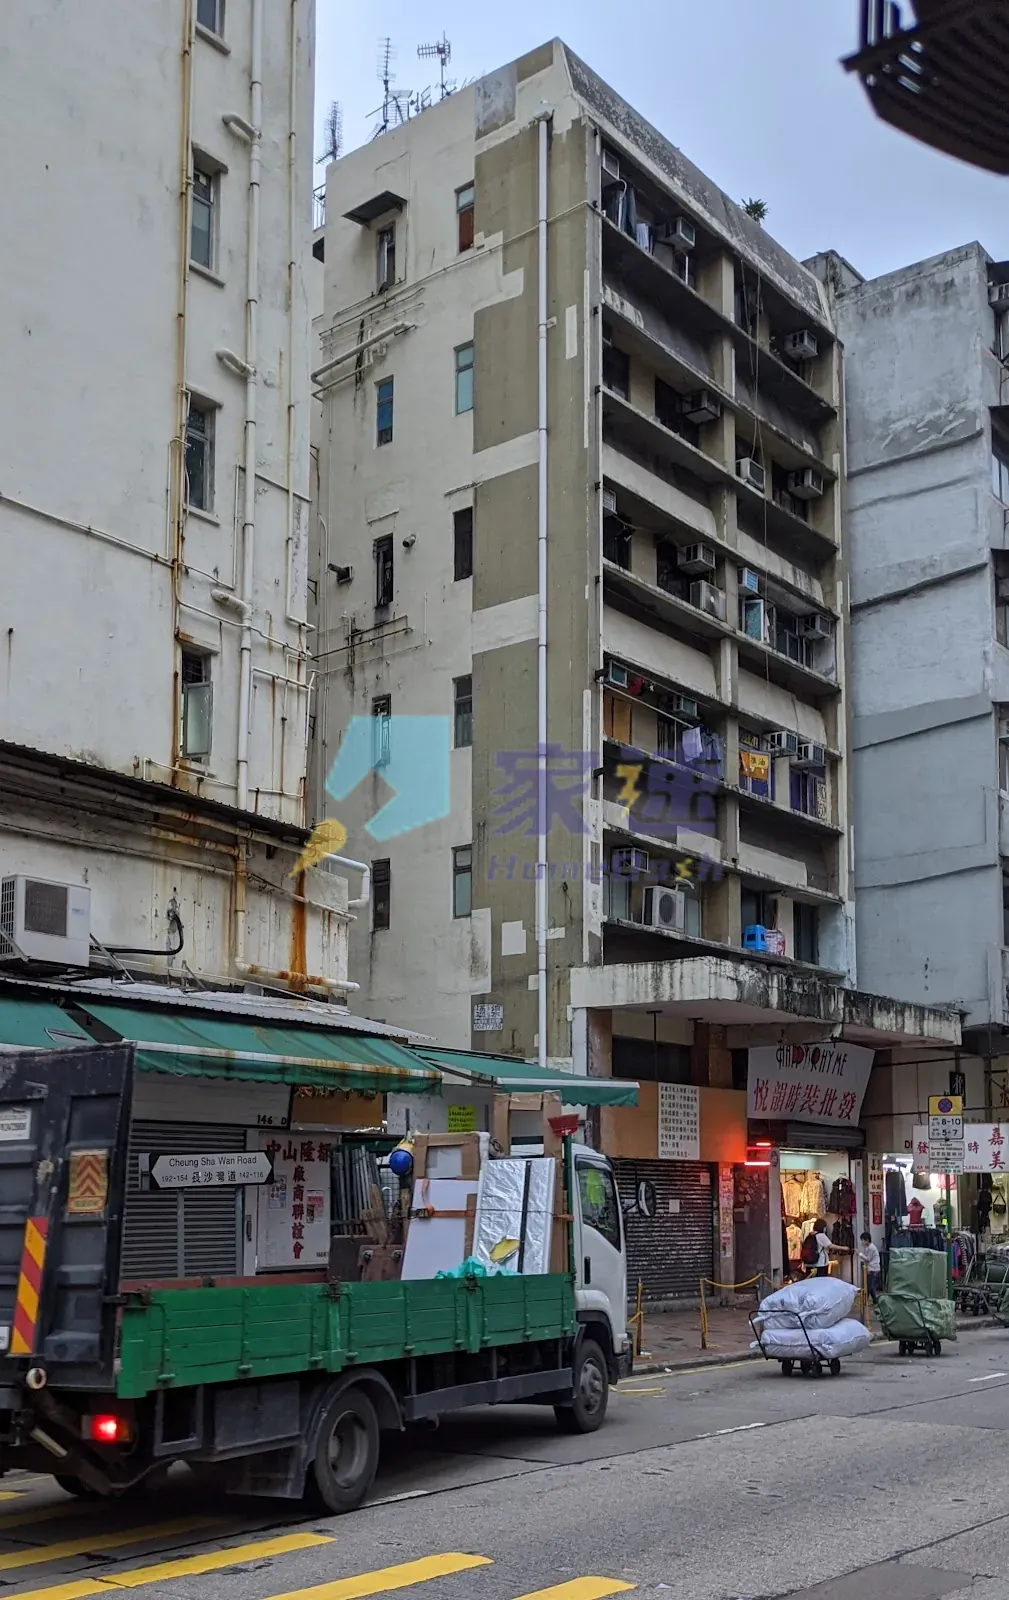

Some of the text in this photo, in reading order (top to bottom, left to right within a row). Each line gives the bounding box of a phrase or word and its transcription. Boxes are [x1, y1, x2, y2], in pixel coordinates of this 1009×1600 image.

[811, 1047, 848, 1076] RHYME
[257, 1114, 273, 1125] 146
[941, 1118, 961, 1126] 8-10
[942, 1129, 958, 1137] 5-7
[967, 1141, 980, 1154] 時
[988, 1127, 1006, 1170] 嘉美
[168, 1155, 257, 1168] Cheung Sha Wan Road
[162, 1174, 188, 1182] 192-154
[191, 1170, 237, 1183] 長沙灣道
